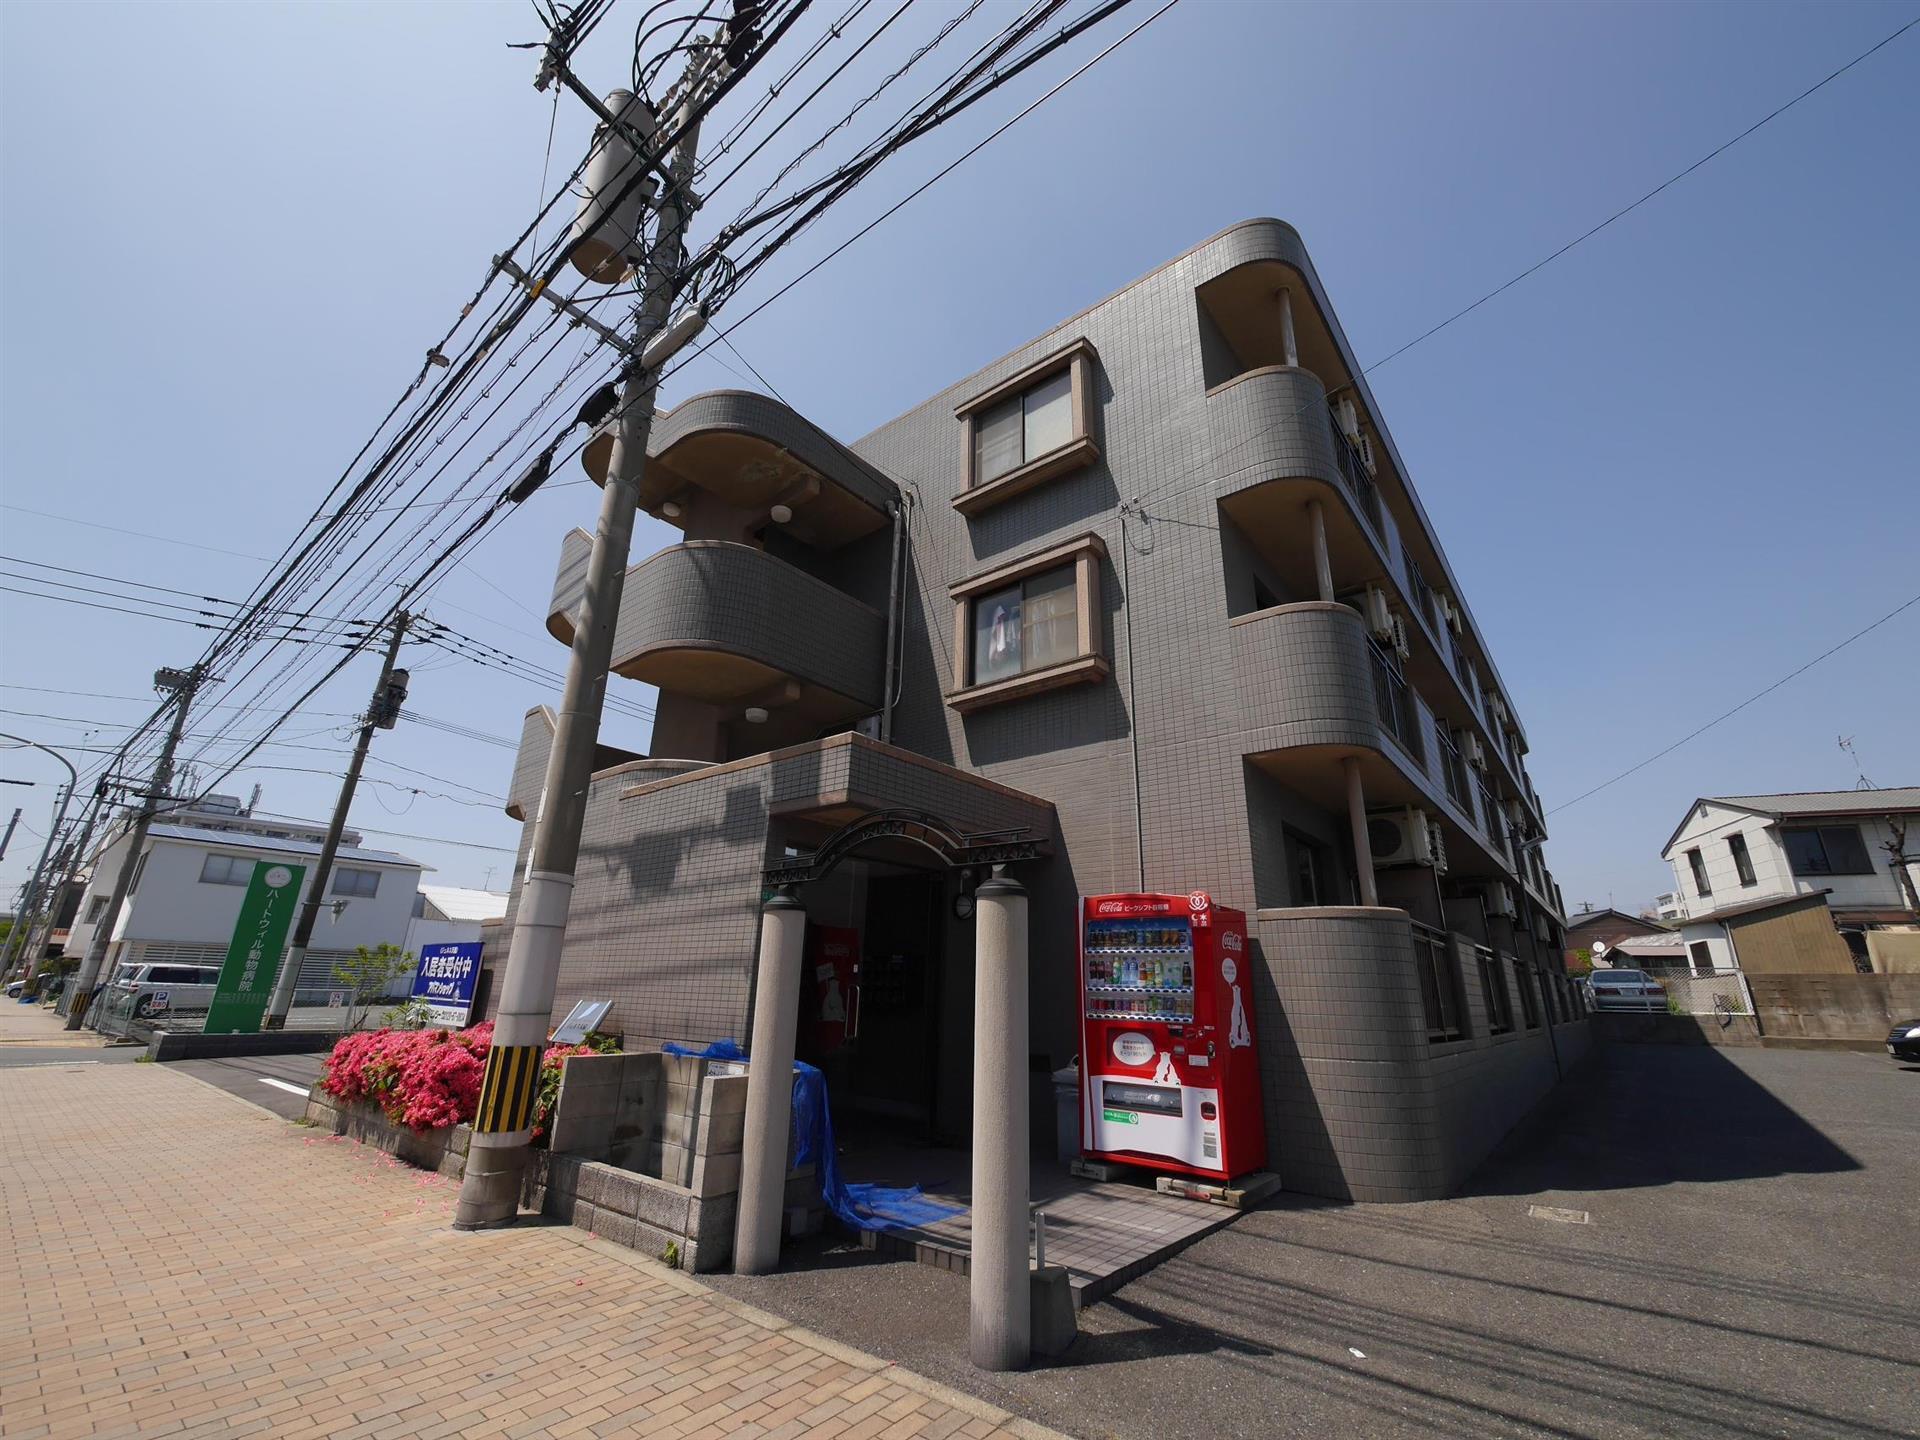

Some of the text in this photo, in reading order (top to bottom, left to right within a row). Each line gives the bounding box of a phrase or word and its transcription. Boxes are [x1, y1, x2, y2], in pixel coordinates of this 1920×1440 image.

[238, 888, 280, 992] ハートウィル動物病院
[421, 956, 472, 979] 入居者受付中
